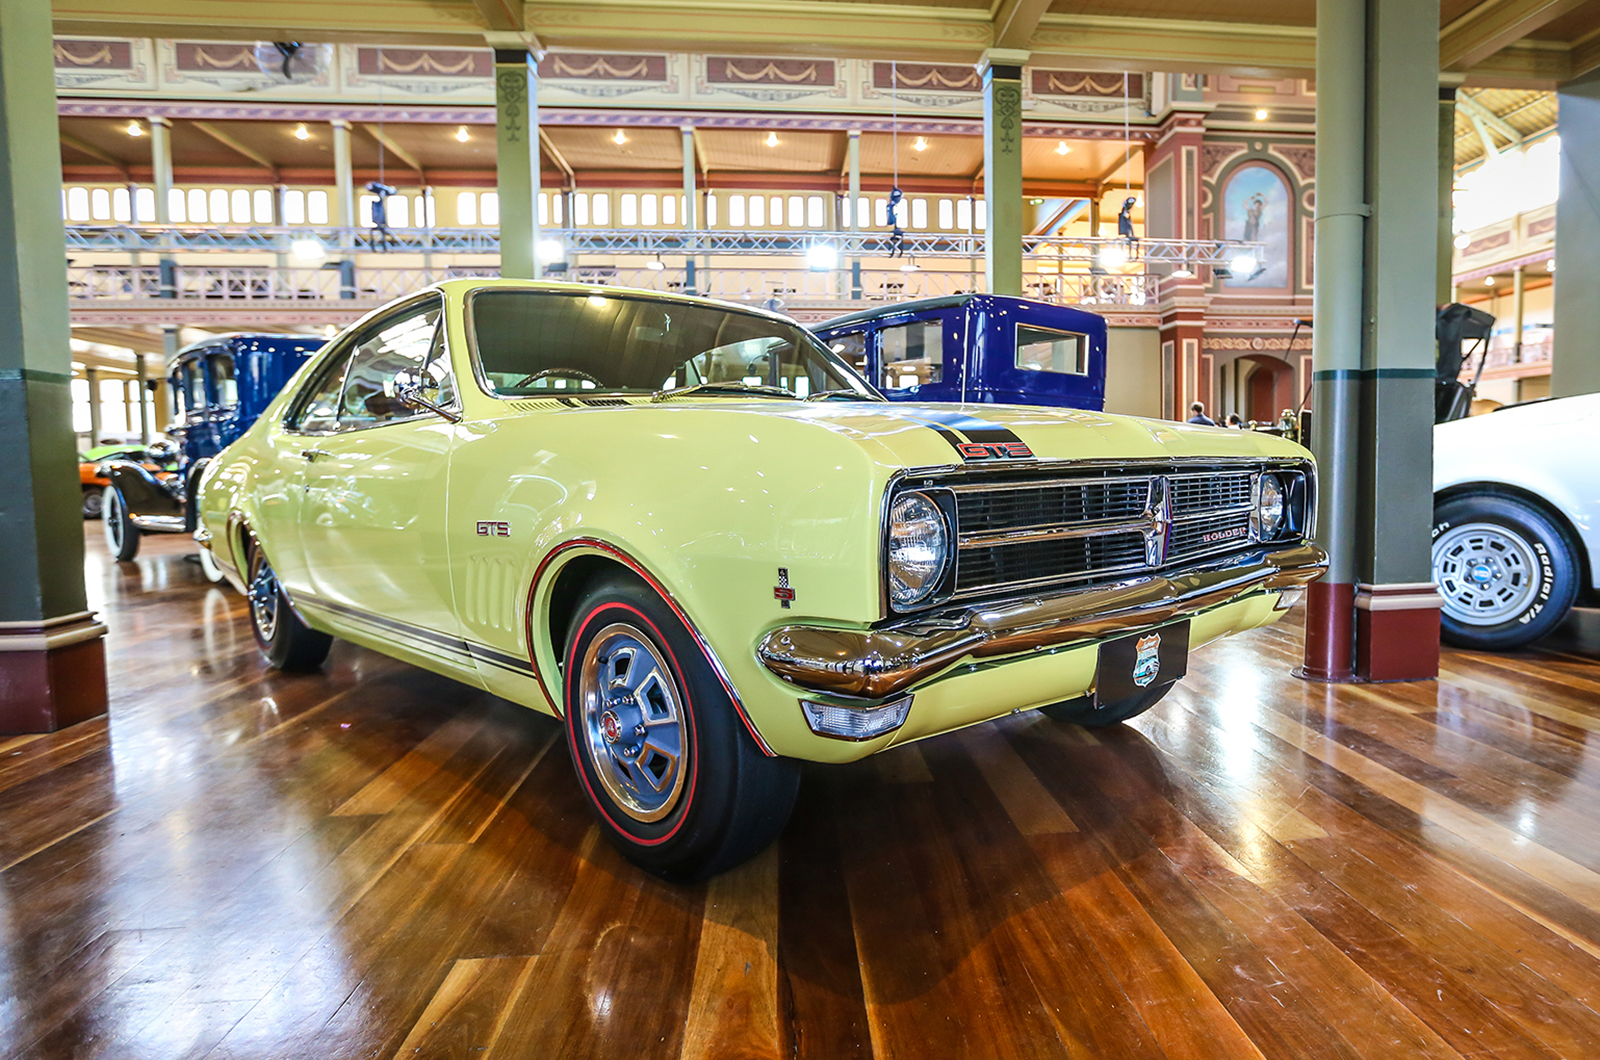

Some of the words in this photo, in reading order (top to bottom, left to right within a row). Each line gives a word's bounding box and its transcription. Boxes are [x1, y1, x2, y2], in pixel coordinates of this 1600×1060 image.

[957, 442, 1033, 458] GTS
[476, 520, 511, 537] GTS
[1533, 543, 1554, 600] Radial
[1518, 603, 1544, 624] T/A
